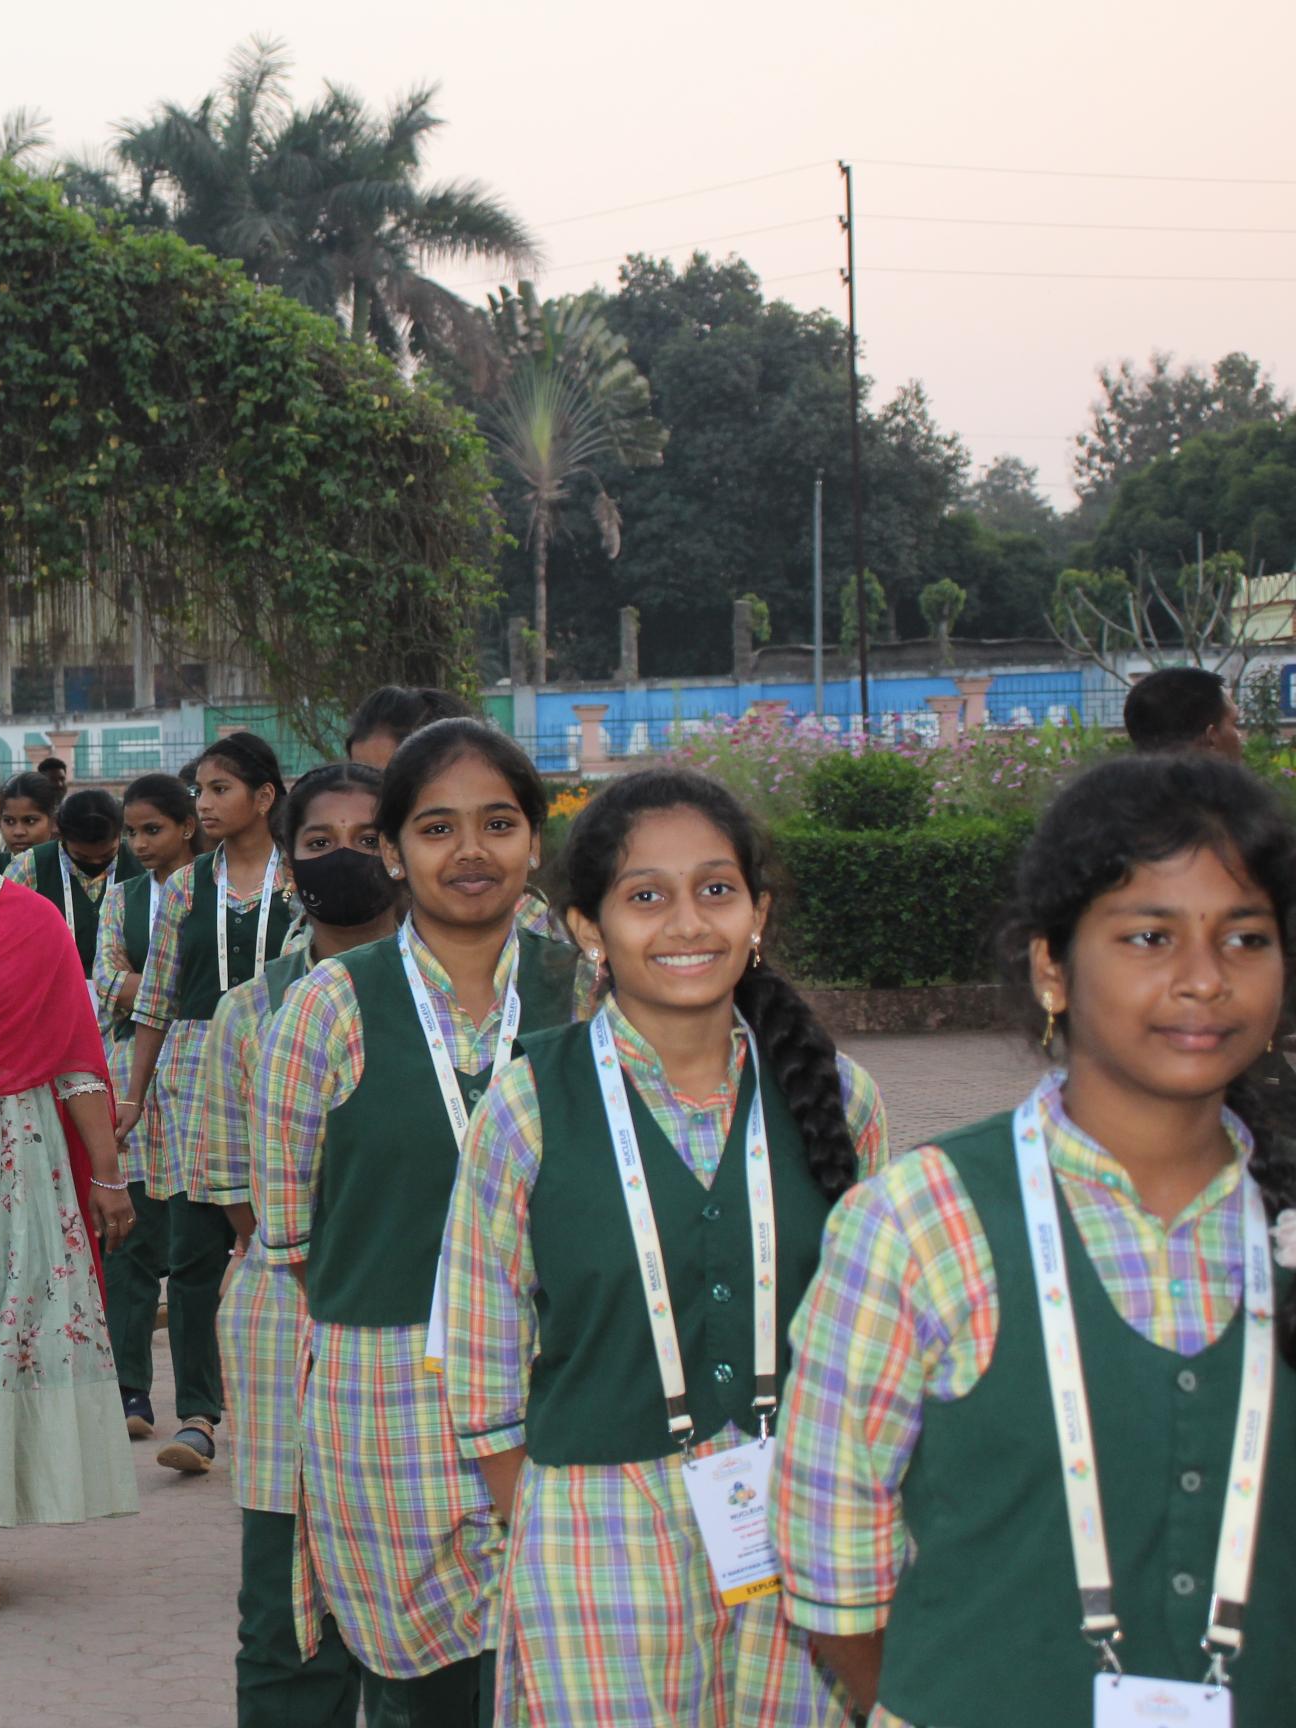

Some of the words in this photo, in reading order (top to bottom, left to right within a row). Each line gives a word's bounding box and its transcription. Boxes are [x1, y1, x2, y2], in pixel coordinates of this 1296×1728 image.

[419, 1001, 435, 1033] NUCLEUS
[505, 996, 518, 1028] NUCLEUS
[448, 1097, 465, 1130] NUCLEUS
[617, 1128, 634, 1167] NUCLEUS
[758, 1222, 768, 1263] NUCLEUS
[1037, 1222, 1054, 1275] NUCLEUS
[643, 1250, 660, 1293] NUCLEUS
[1251, 1244, 1265, 1294] NUCLEUS
[1060, 1390, 1078, 1444] NUCLEUS
[1241, 1409, 1257, 1463] NUCLEUS
[730, 1505, 765, 1520] NUCLEUS
